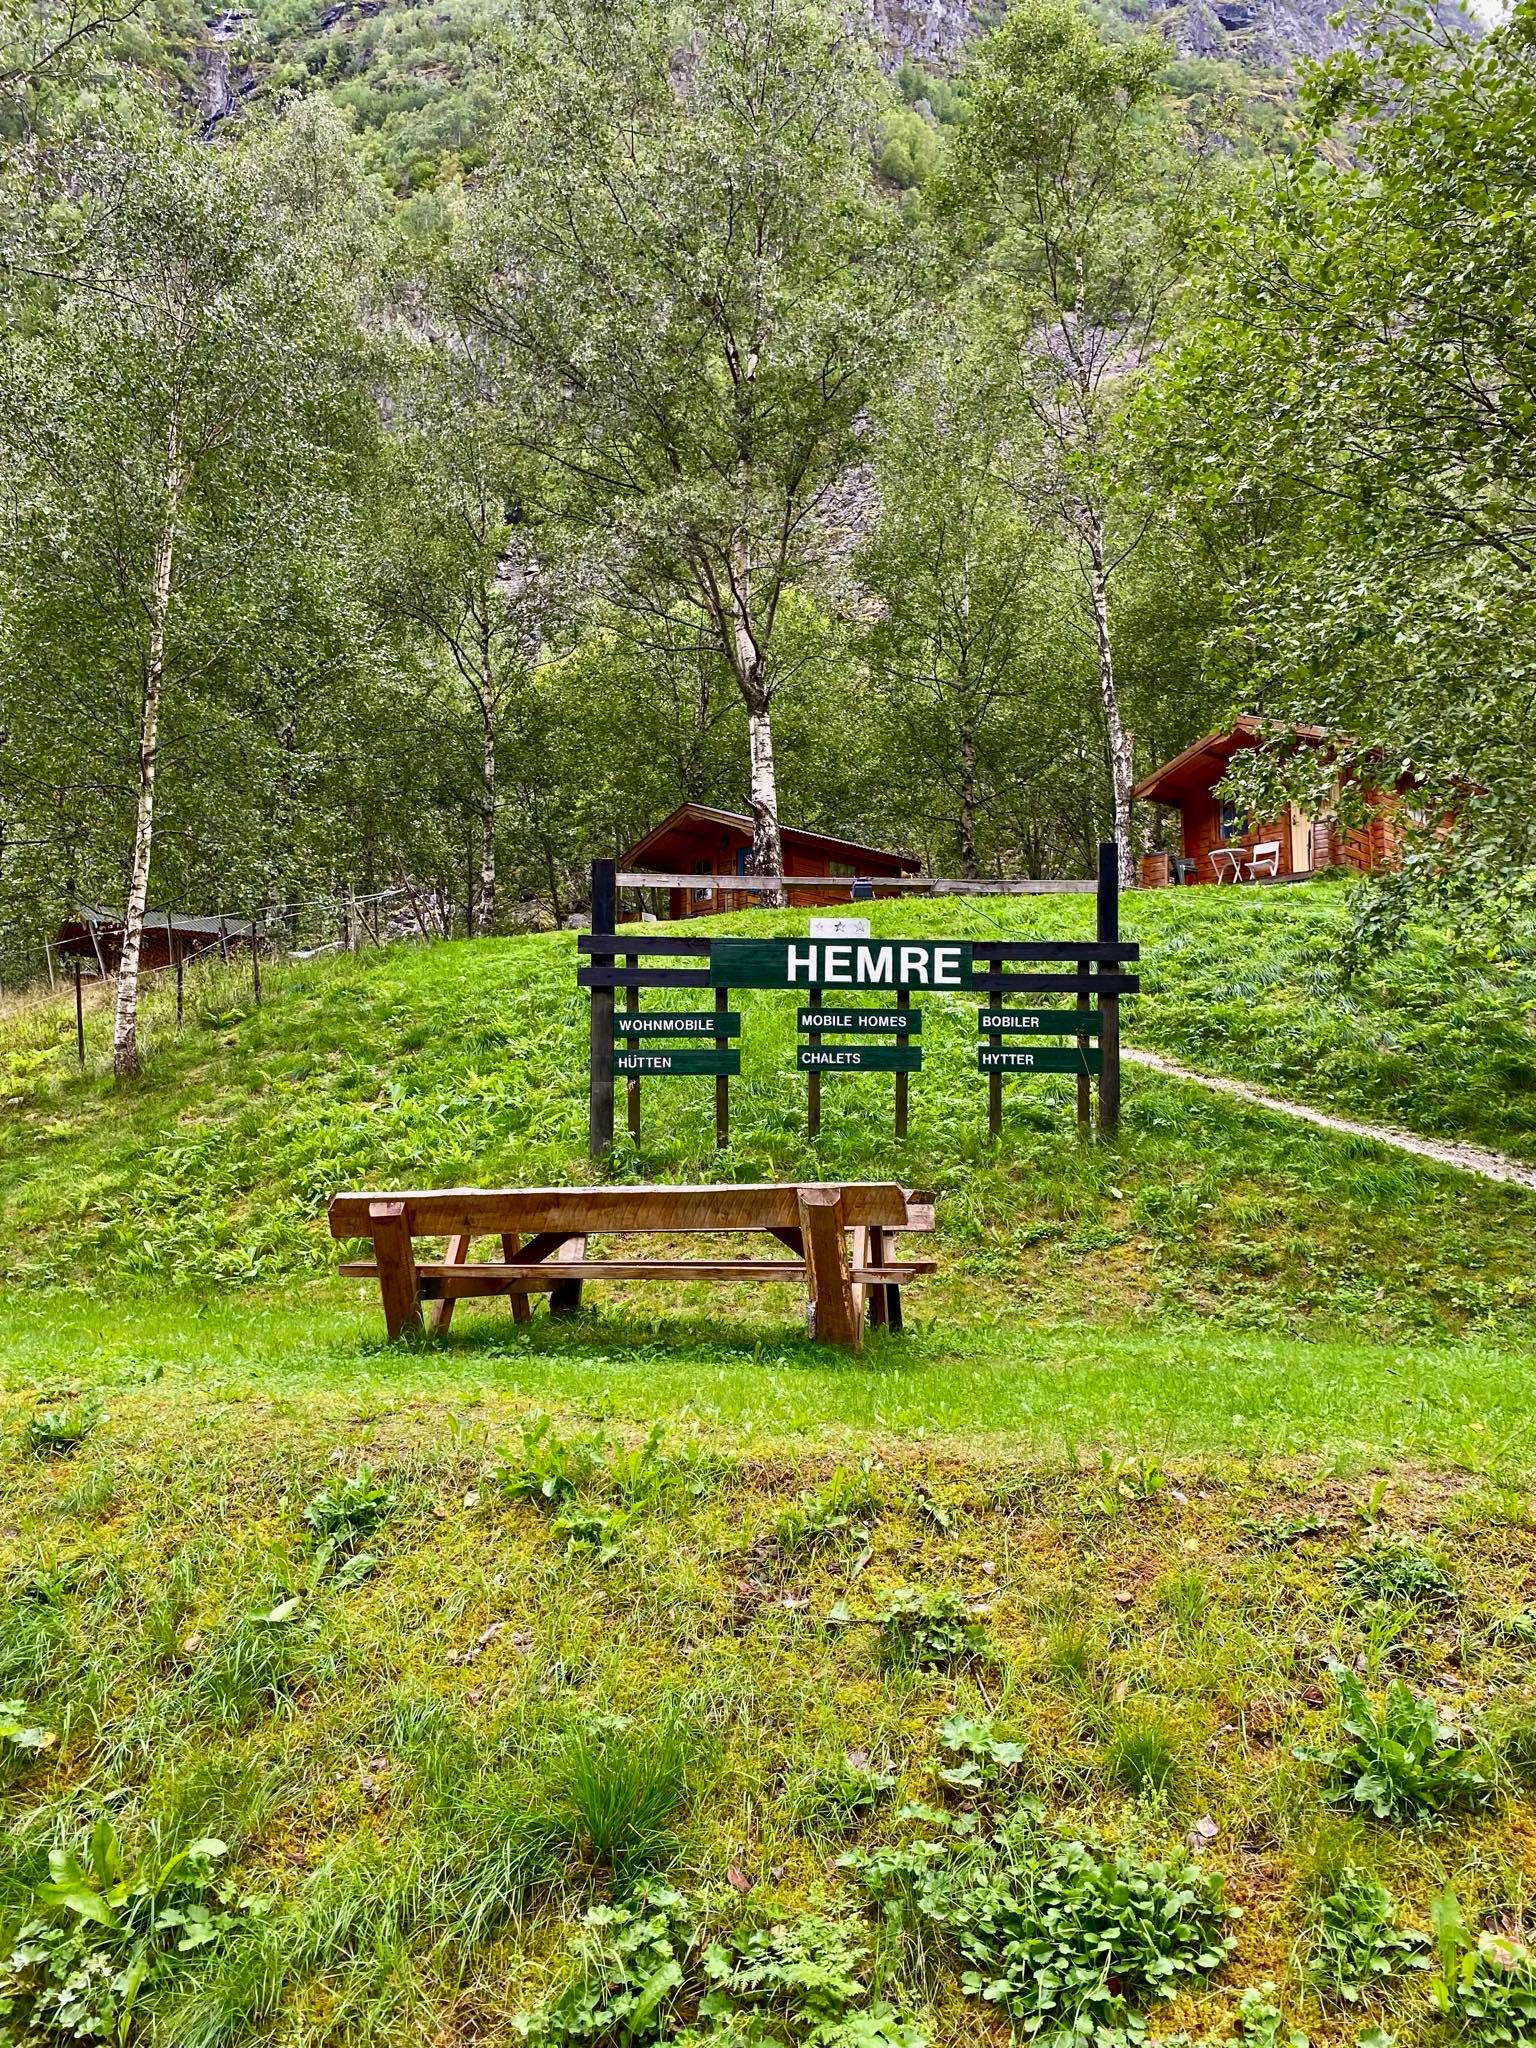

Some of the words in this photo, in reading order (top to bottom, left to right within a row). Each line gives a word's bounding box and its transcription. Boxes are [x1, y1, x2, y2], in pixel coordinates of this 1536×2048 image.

[787, 944, 962, 985] HEMRE
[619, 1019, 714, 1031] WOHNMOBILE
[801, 1014, 852, 1027] MOBILE
[858, 1015, 907, 1028] HOMES
[982, 1015, 1040, 1028] BOBILER
[618, 1054, 672, 1068] HÜTTEN
[801, 1051, 861, 1065] CHALETS
[982, 1053, 1034, 1065] HYTTER
